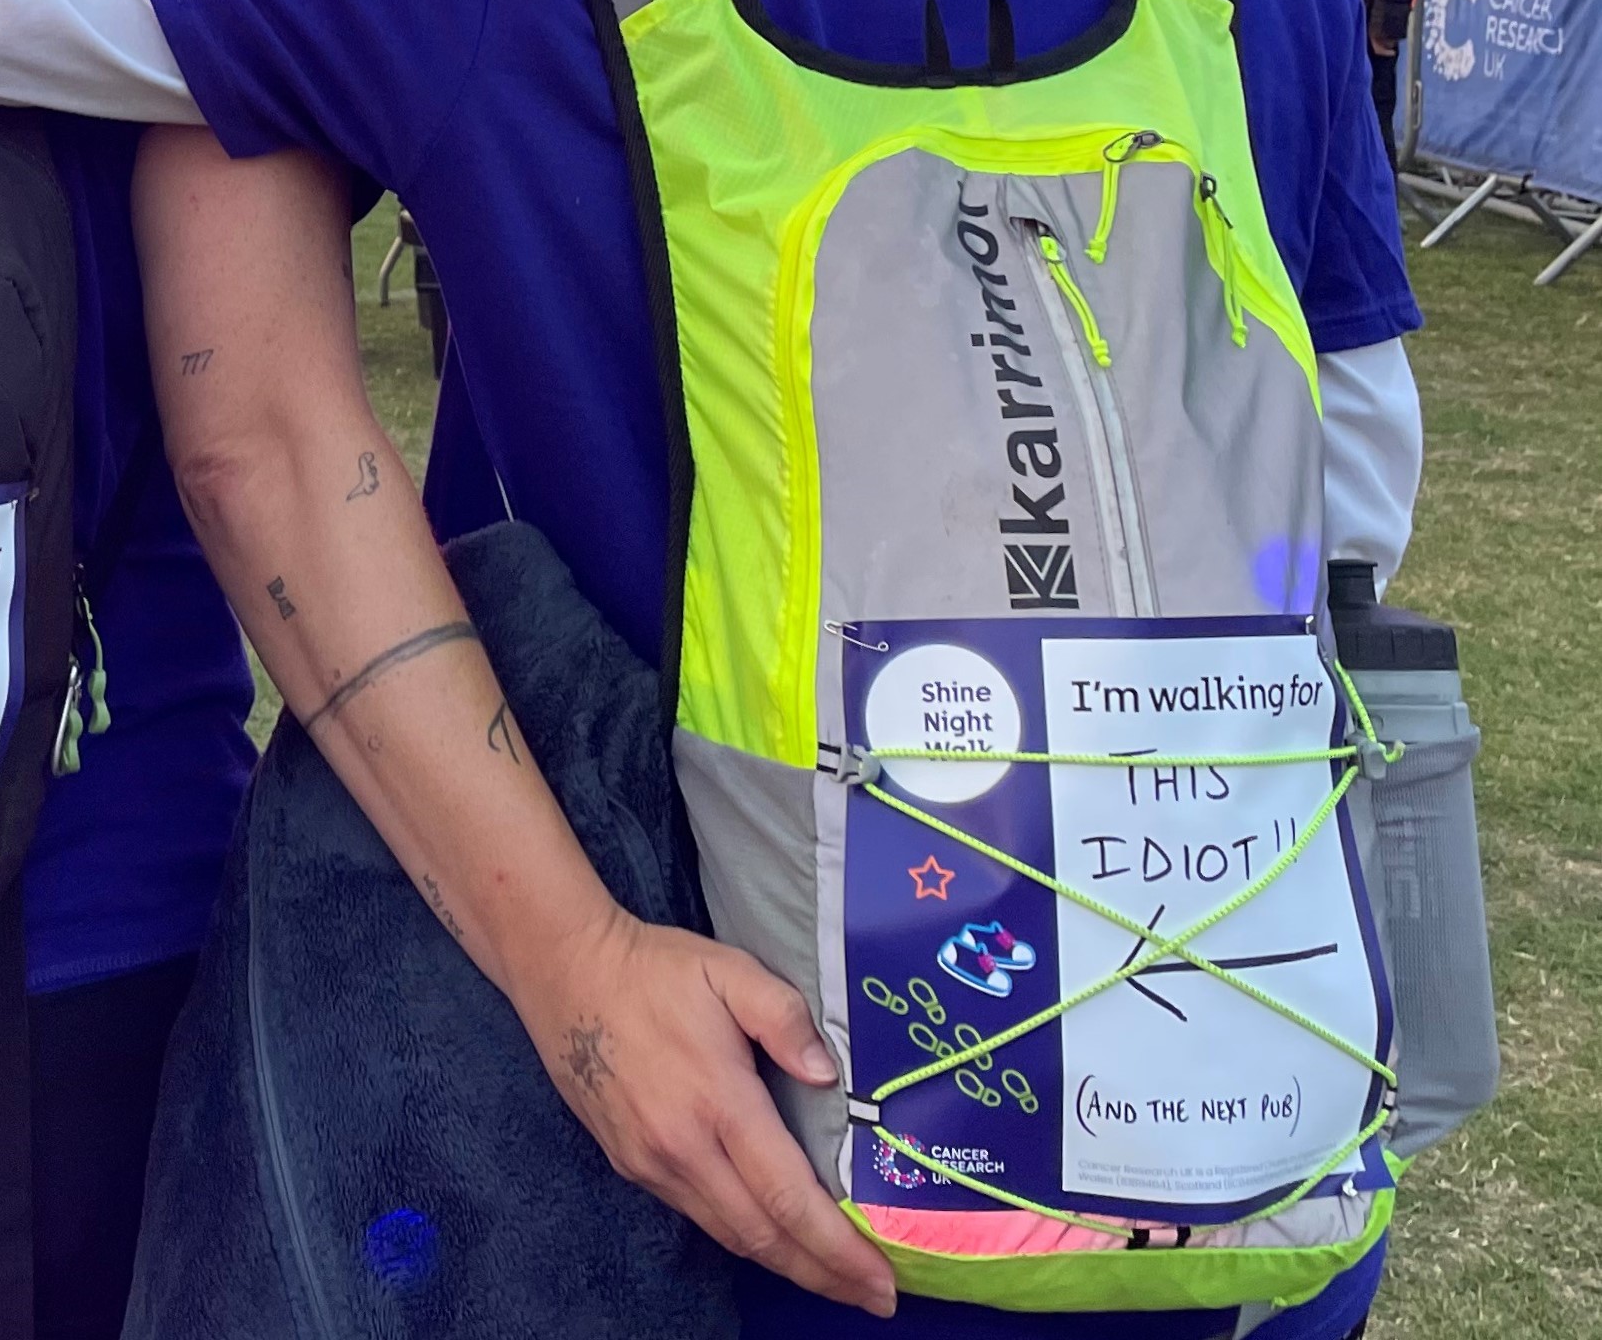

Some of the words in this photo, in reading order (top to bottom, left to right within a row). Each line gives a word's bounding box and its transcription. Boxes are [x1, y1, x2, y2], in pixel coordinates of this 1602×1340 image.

[1484, 48, 1506, 80] UK
[957, 181, 1070, 533] karrimor
[922, 681, 991, 703] Shine
[1071, 679, 1139, 713] I'm
[1149, 676, 1284, 717] walking
[1290, 677, 1324, 708] for
[924, 710, 993, 737] Night
[1109, 748, 1230, 805] THIS
[1076, 1075, 1137, 1138] (AND
[1146, 1098, 1189, 1123] THE
[1201, 1097, 1248, 1124] NEXT
[1261, 1075, 1301, 1138] PUB)
[931, 1145, 989, 1161] CANCER
